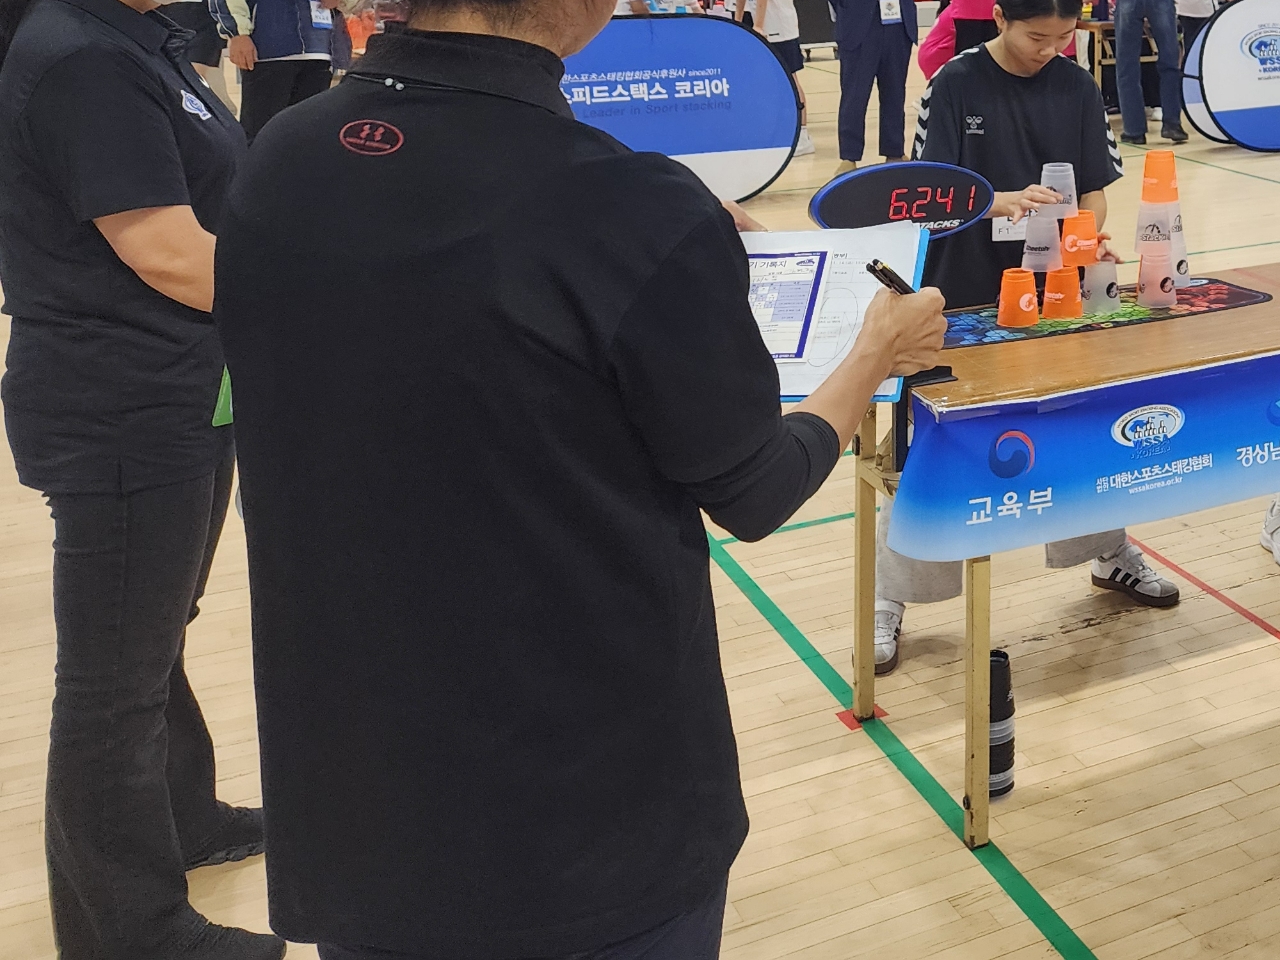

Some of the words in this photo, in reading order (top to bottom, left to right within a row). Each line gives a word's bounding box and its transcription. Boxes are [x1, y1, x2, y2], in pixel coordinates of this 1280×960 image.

[674, 78, 730, 99] 코리아
[645, 103, 678, 117] Sport
[682, 100, 732, 114] stacking
[888, 184, 977, 220] 6.241
[1133, 434, 1171, 450] WSSA
[1110, 453, 1213, 489] 대한스포츠스태킹협회
[1129, 476, 1183, 494] wssakorea.or.kr
[965, 487, 1053, 526] 교육부
